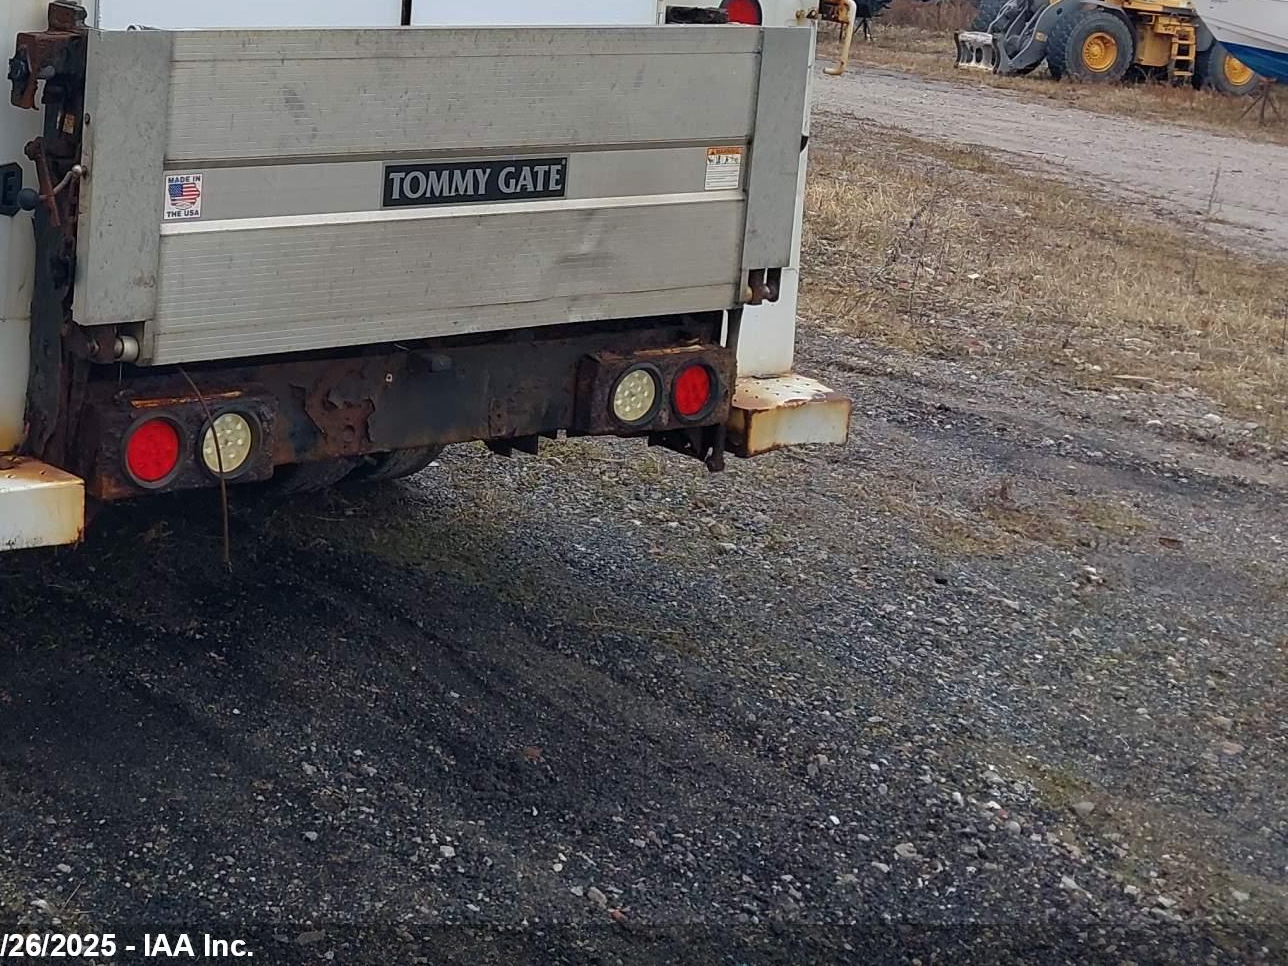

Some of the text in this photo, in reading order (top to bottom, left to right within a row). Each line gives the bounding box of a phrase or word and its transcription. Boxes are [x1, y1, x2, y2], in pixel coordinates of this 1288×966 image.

[168, 176, 191, 184] MADE
[389, 165, 562, 200] TOMMY GATE
[167, 209, 200, 218] THE USA
